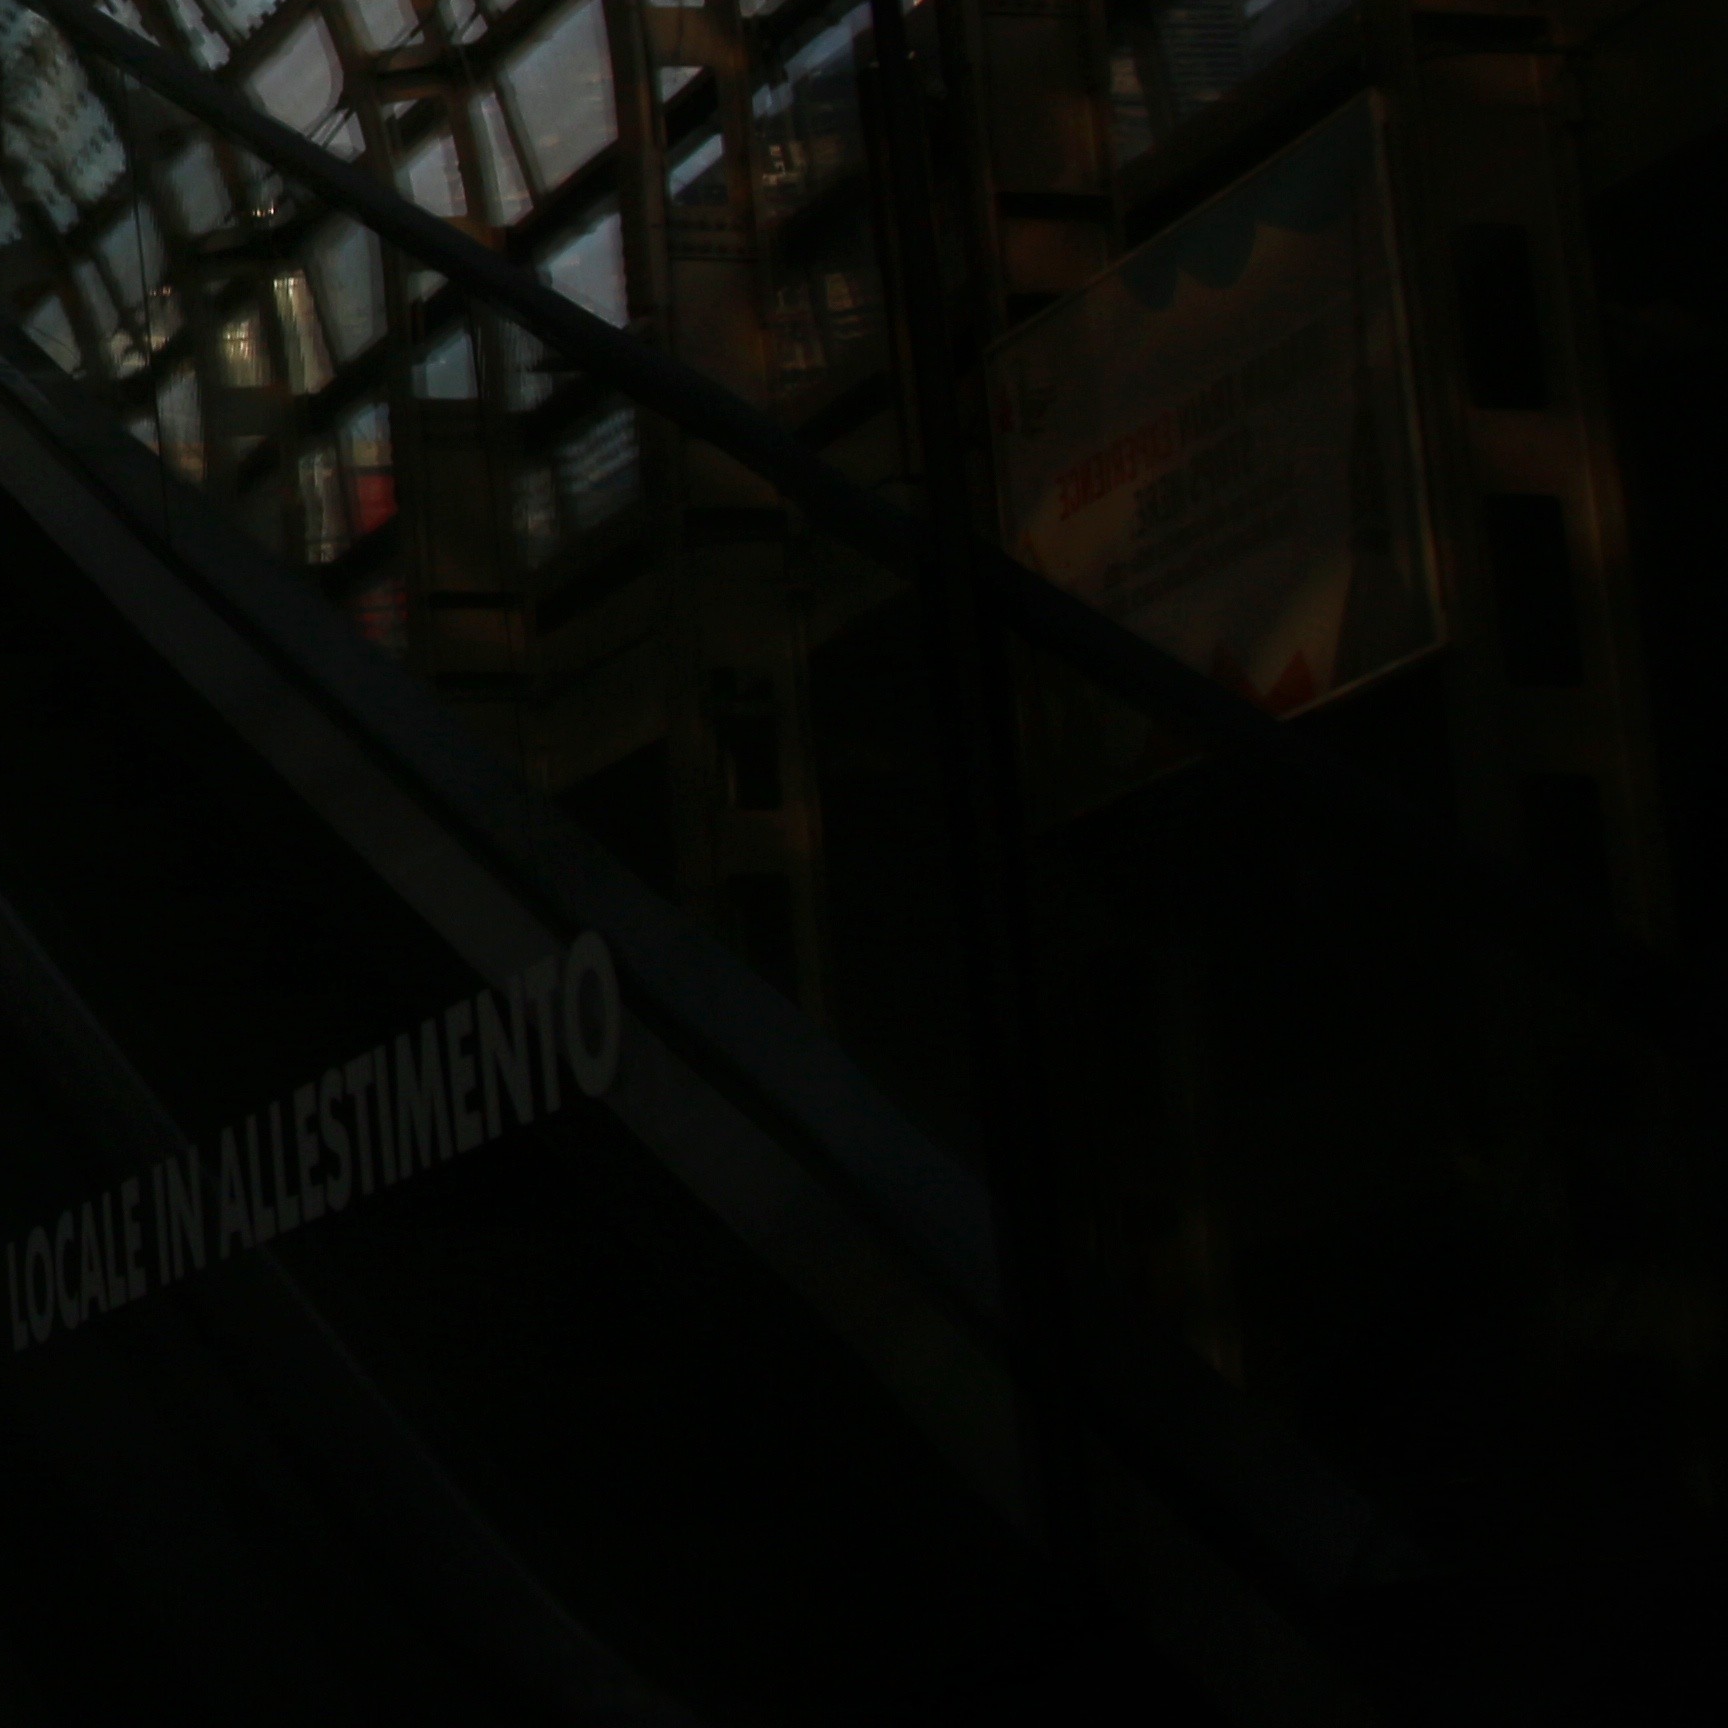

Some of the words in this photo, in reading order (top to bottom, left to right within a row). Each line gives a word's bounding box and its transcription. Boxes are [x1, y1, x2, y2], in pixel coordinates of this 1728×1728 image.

[6, 1176, 146, 1353] LOCALE
[152, 1145, 206, 1287] IN
[218, 929, 621, 1260] ALLESTIMENTO
